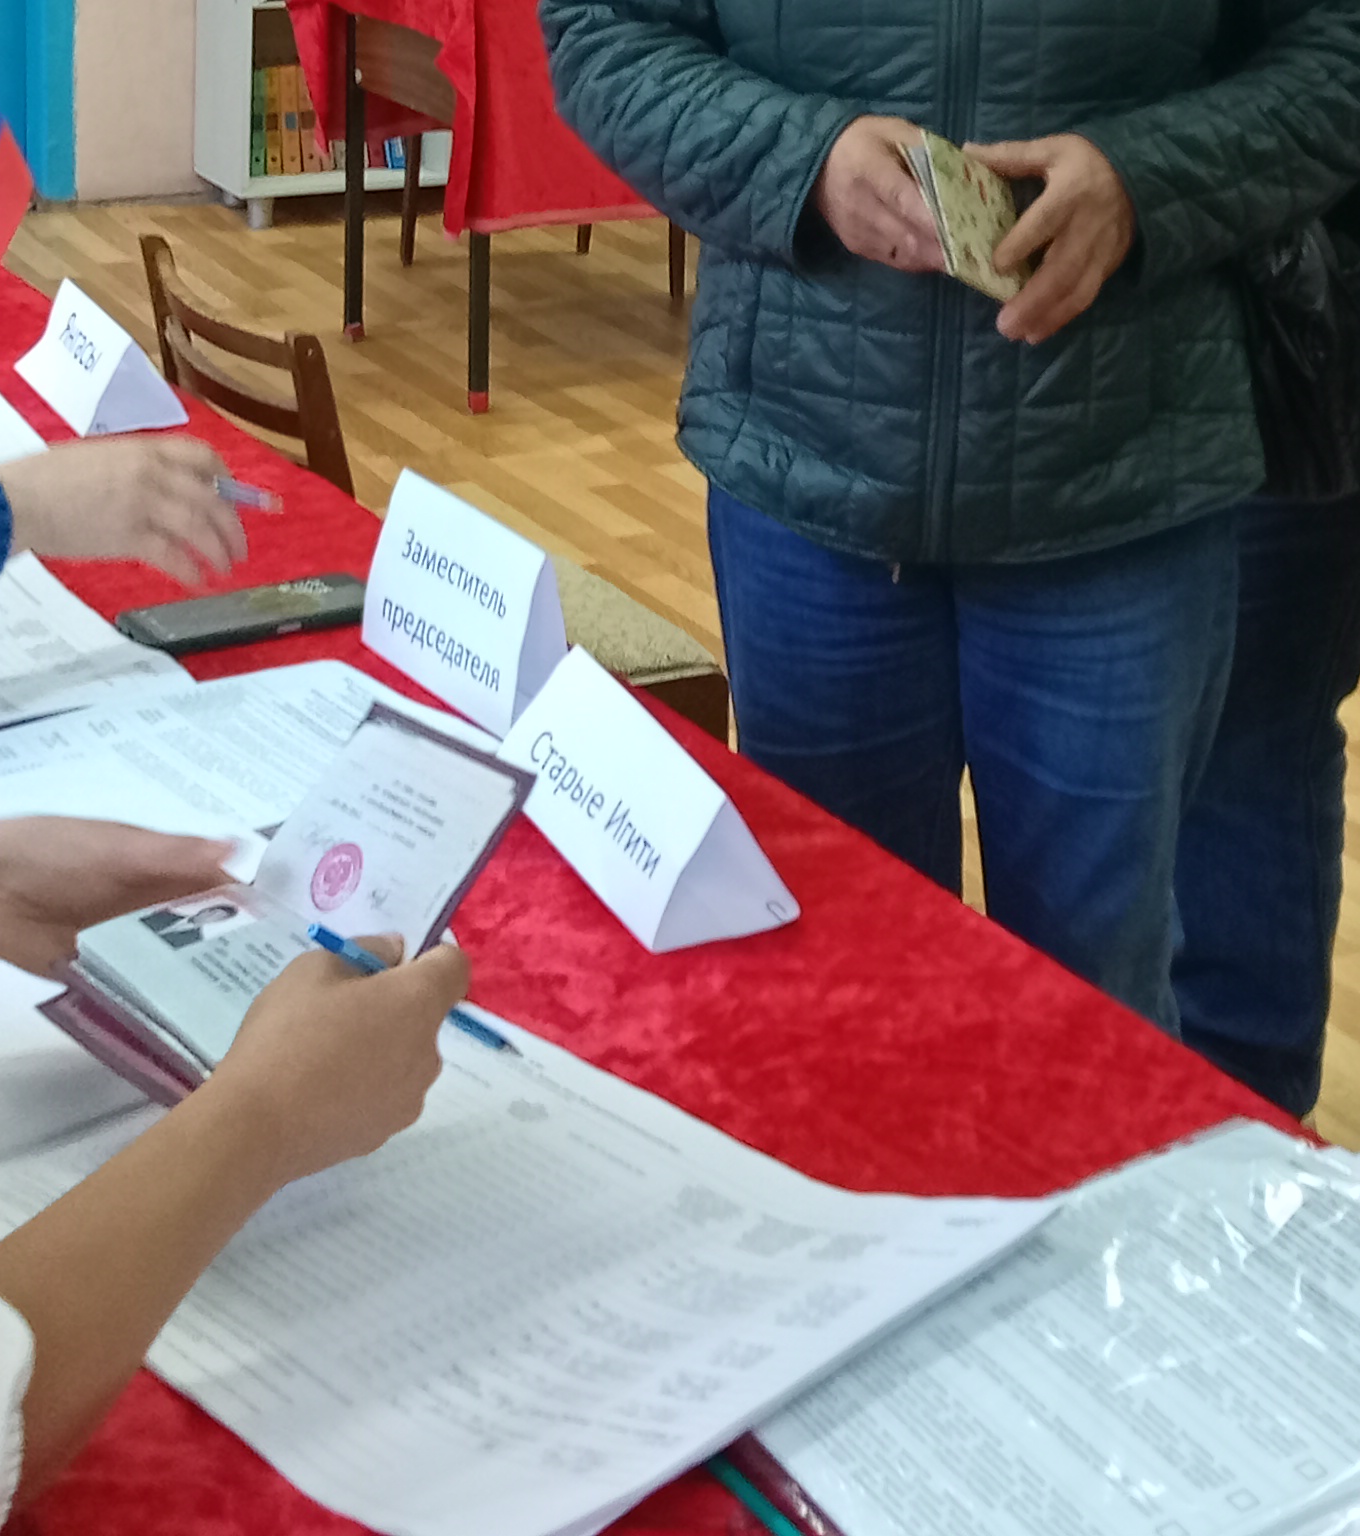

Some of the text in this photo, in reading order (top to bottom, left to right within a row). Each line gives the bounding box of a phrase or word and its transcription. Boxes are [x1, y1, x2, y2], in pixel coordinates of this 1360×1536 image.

[401, 528, 507, 620] Заместитель
[381, 597, 501, 693] председателя
[530, 730, 606, 819] Старые
[603, 798, 662, 880] Игити
